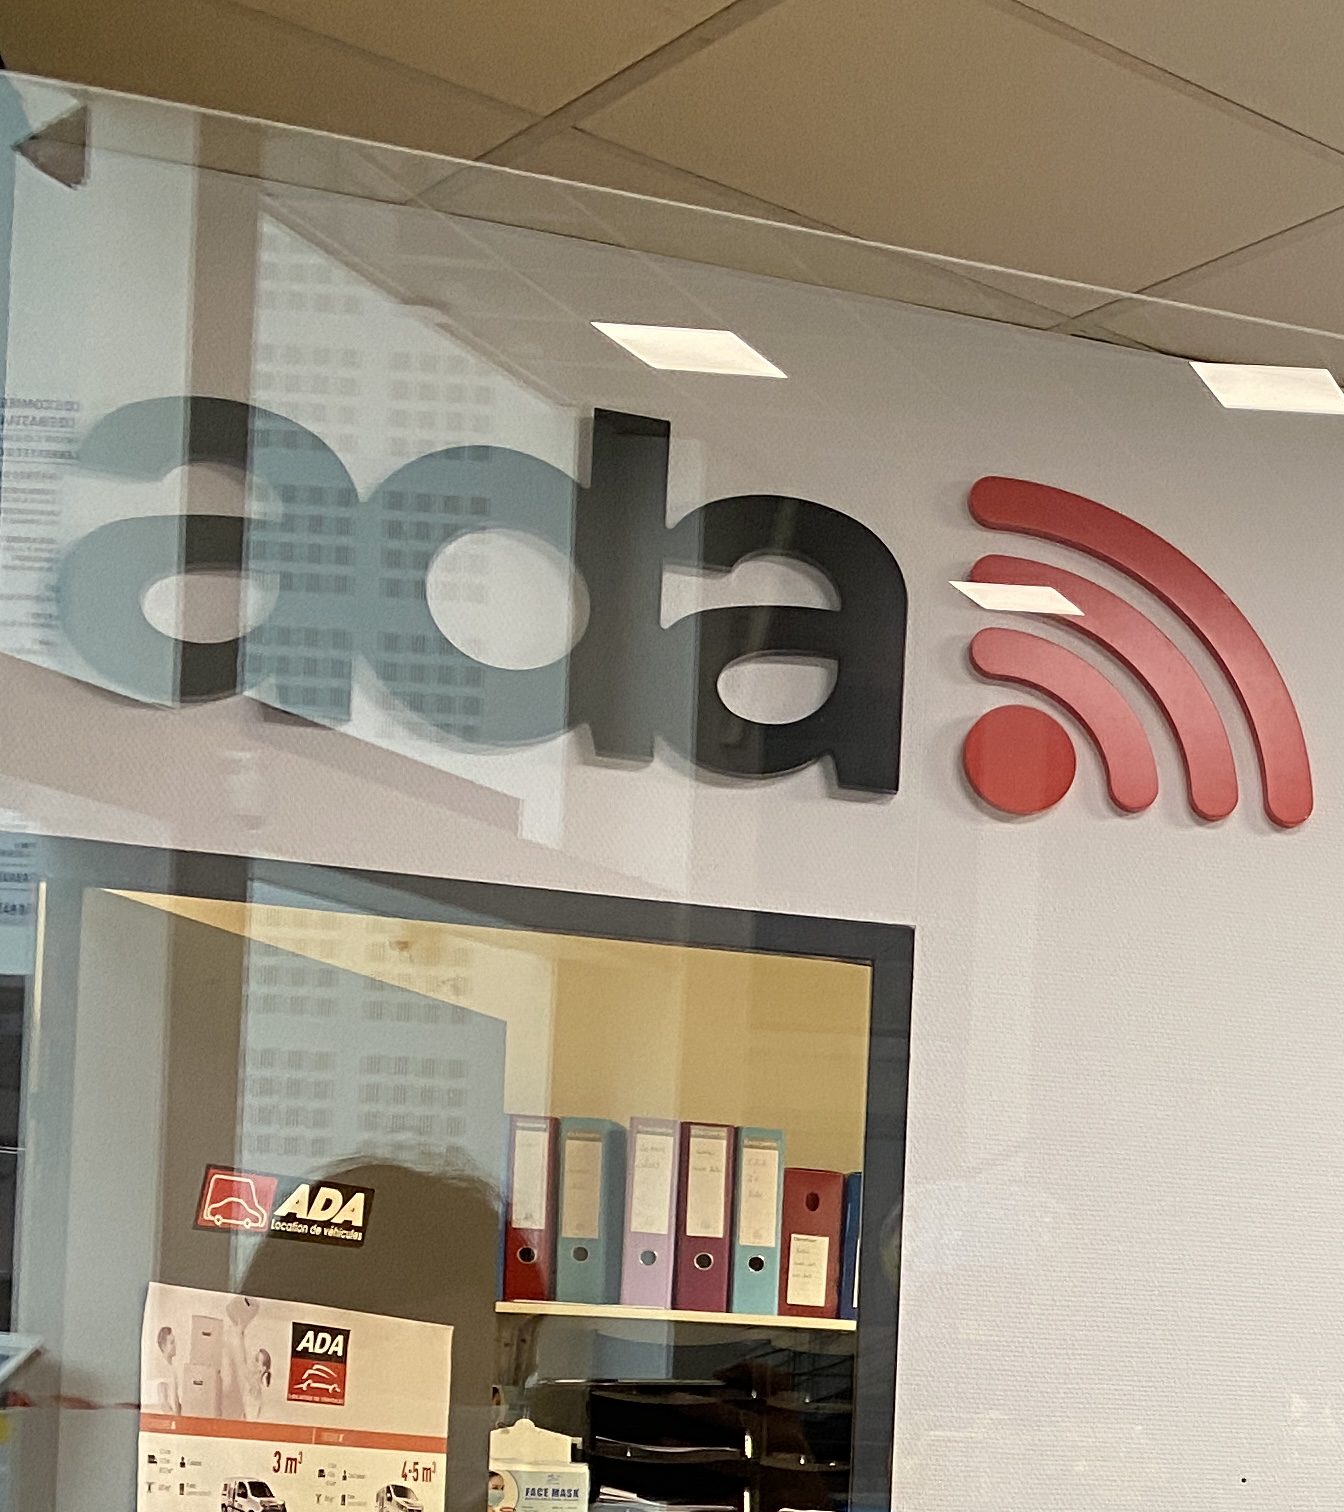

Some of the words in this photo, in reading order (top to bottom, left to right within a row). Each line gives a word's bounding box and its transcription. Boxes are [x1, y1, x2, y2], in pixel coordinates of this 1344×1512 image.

[56, 396, 908, 798] ada
[274, 1184, 366, 1227] ADA
[310, 1224, 322, 1236] de
[296, 1330, 344, 1357] ADA
[272, 1450, 282, 1474] 3
[525, 1487, 549, 1497] FACE
[551, 1488, 580, 1498] MASK
